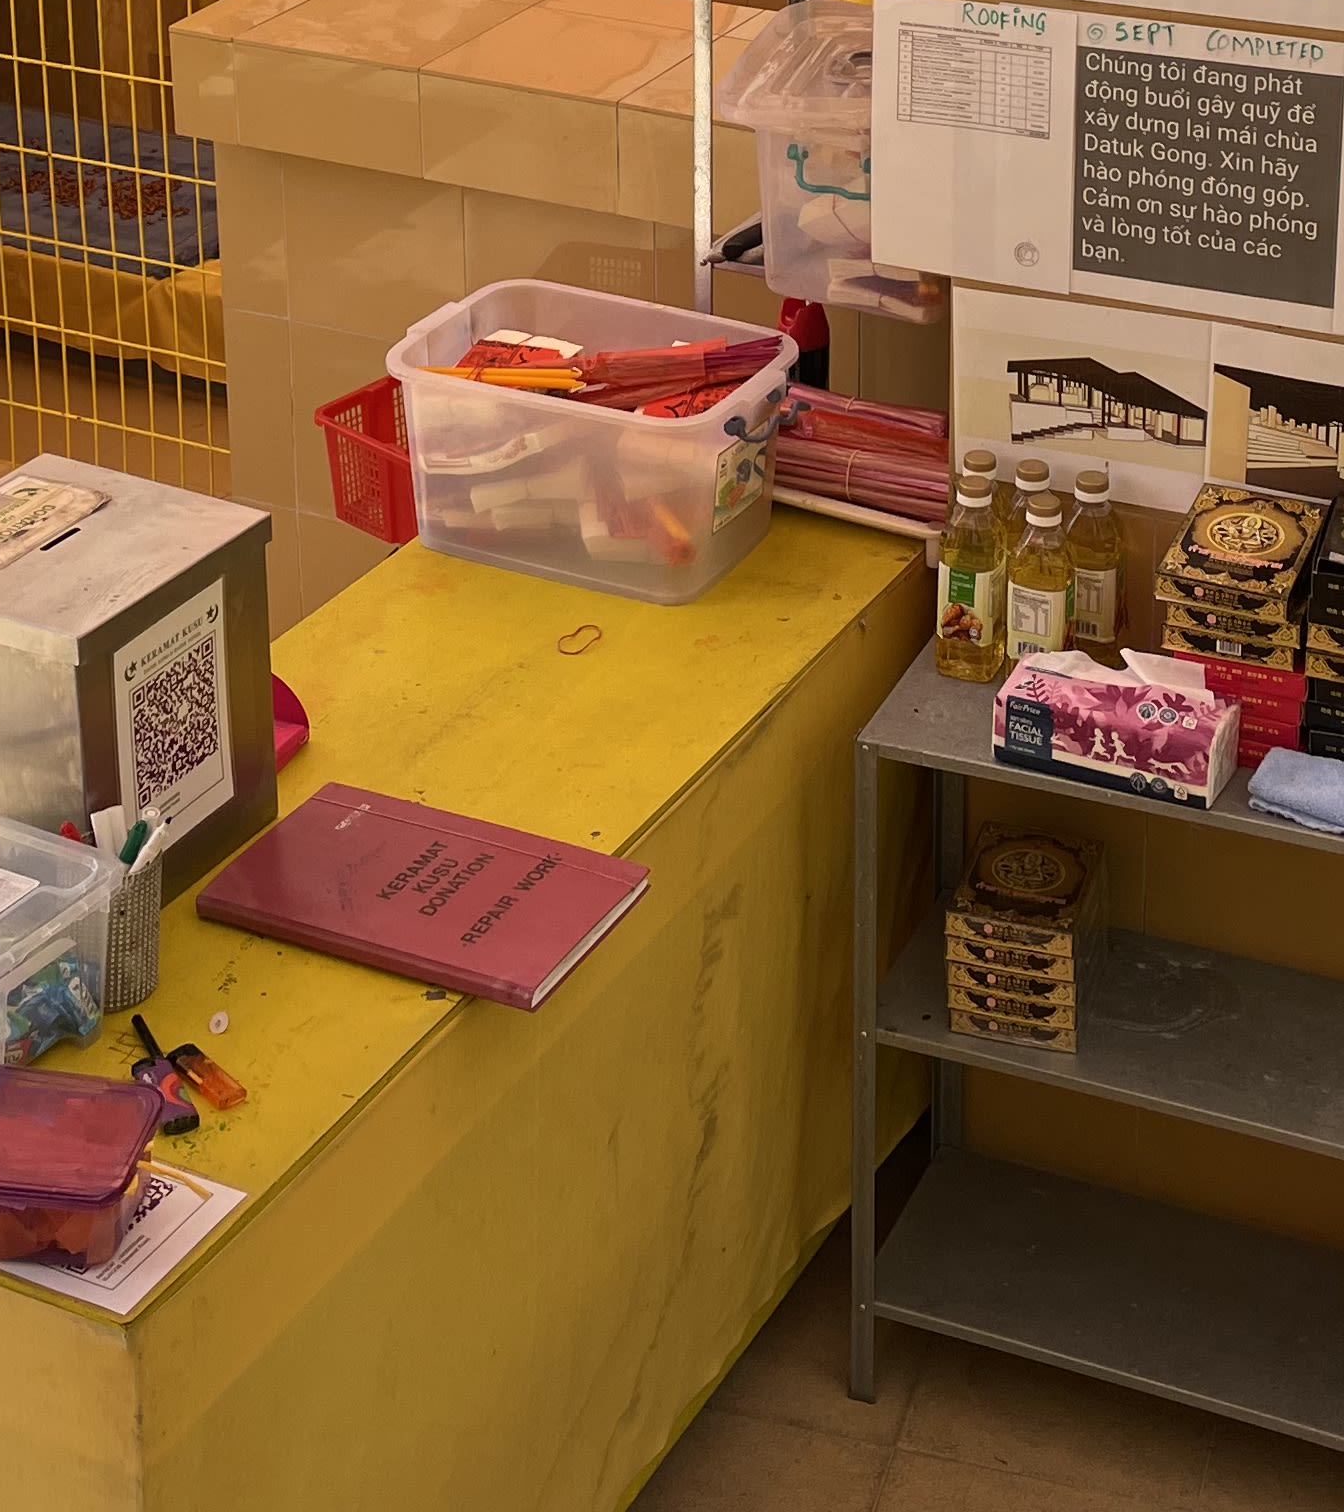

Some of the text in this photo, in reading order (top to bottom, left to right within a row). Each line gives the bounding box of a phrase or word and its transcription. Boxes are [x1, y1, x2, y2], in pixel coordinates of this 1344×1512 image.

[1115, 21, 1176, 47] SEPT
[1206, 29, 1325, 61] COMPLETED
[1085, 52, 1303, 96] Chúng tôi đang phát
[1085, 80, 1316, 125] động buổi gây quỹ để
[1084, 108, 1318, 154] xây dựng lại mái chùa
[1084, 133, 1300, 183] Datuk Gong. Xin hãy
[1083, 159, 1311, 211] hào phóng đóng góp.
[1082, 186, 1319, 241] Cảm ơn sự hào phóng
[1081, 214, 1282, 259] và lòng tốt của các
[1081, 239, 1126, 263] bạn.
[140, 632, 180, 667] KERAMAT
[182, 617, 204, 637] KUSU
[1008, 722, 1044, 737] FACIAL
[1009, 732, 1043, 746] TISSUE
[375, 839, 449, 901] KERAMAT
[412, 857, 459, 895] KUSU
[418, 852, 496, 918] DONATION
